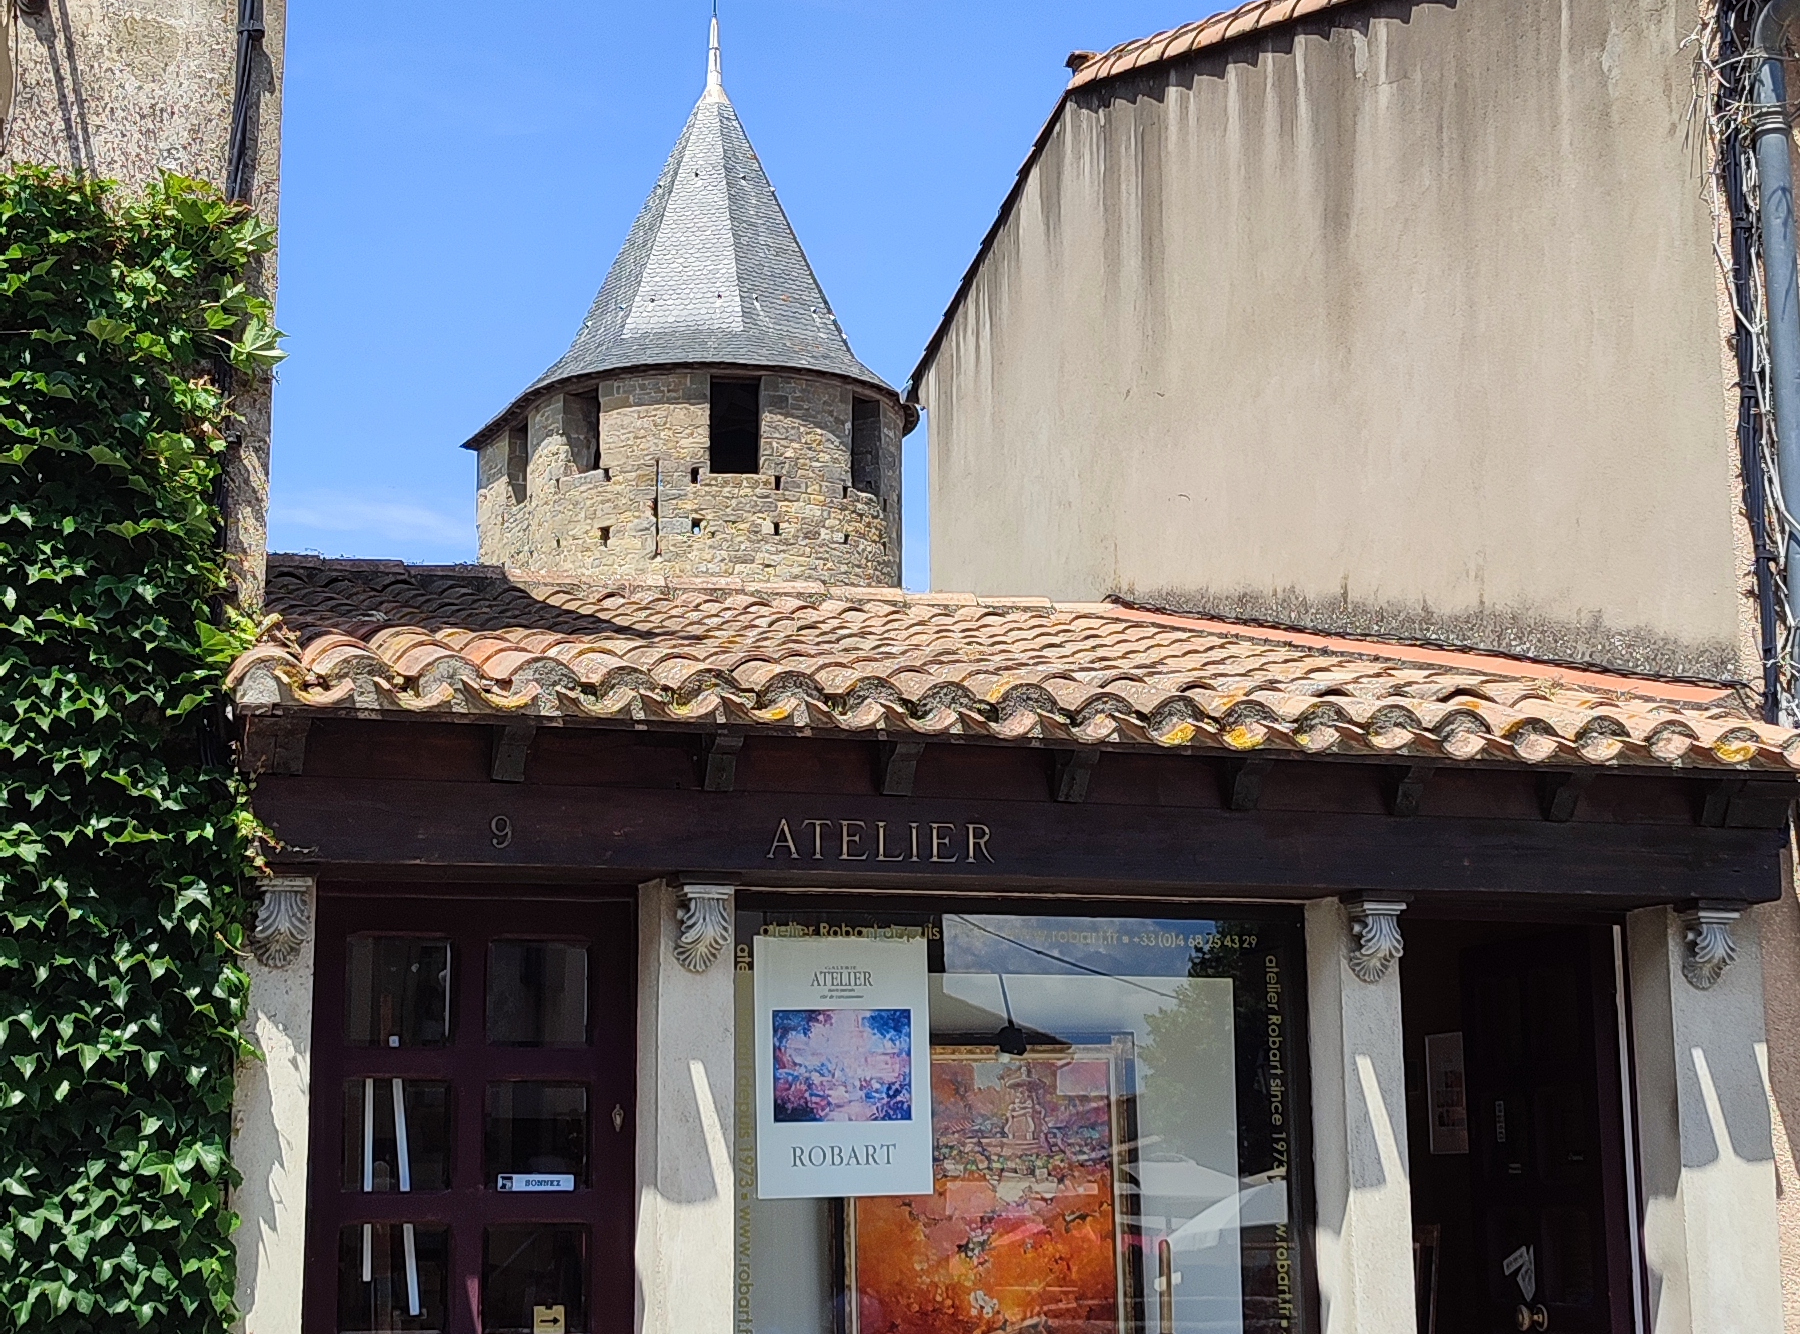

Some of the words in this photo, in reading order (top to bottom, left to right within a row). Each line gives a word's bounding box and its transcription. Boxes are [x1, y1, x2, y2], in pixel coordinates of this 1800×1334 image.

[490, 815, 512, 849] 9
[766, 818, 995, 864] ATELIER
[759, 921, 814, 939] atelier
[819, 921, 879, 940] Robart
[1132, 932, 1156, 947] +33
[1158, 931, 1185, 949] (0)4
[1188, 933, 1203, 948] 68
[1223, 934, 1240, 949] 43
[1242, 934, 1258, 950] 29
[810, 970, 873, 987] ATELIER
[1265, 954, 1282, 1011] atelier
[1268, 1014, 1284, 1075] Robart
[1270, 1078, 1285, 1126] since
[738, 1144, 754, 1190] 1973
[790, 1143, 897, 1168] ROBART
[1272, 1132, 1288, 1170] 1973
[524, 1179, 562, 1187] SONNEZ
[1274, 1223, 1293, 1317] w.robart.fr
